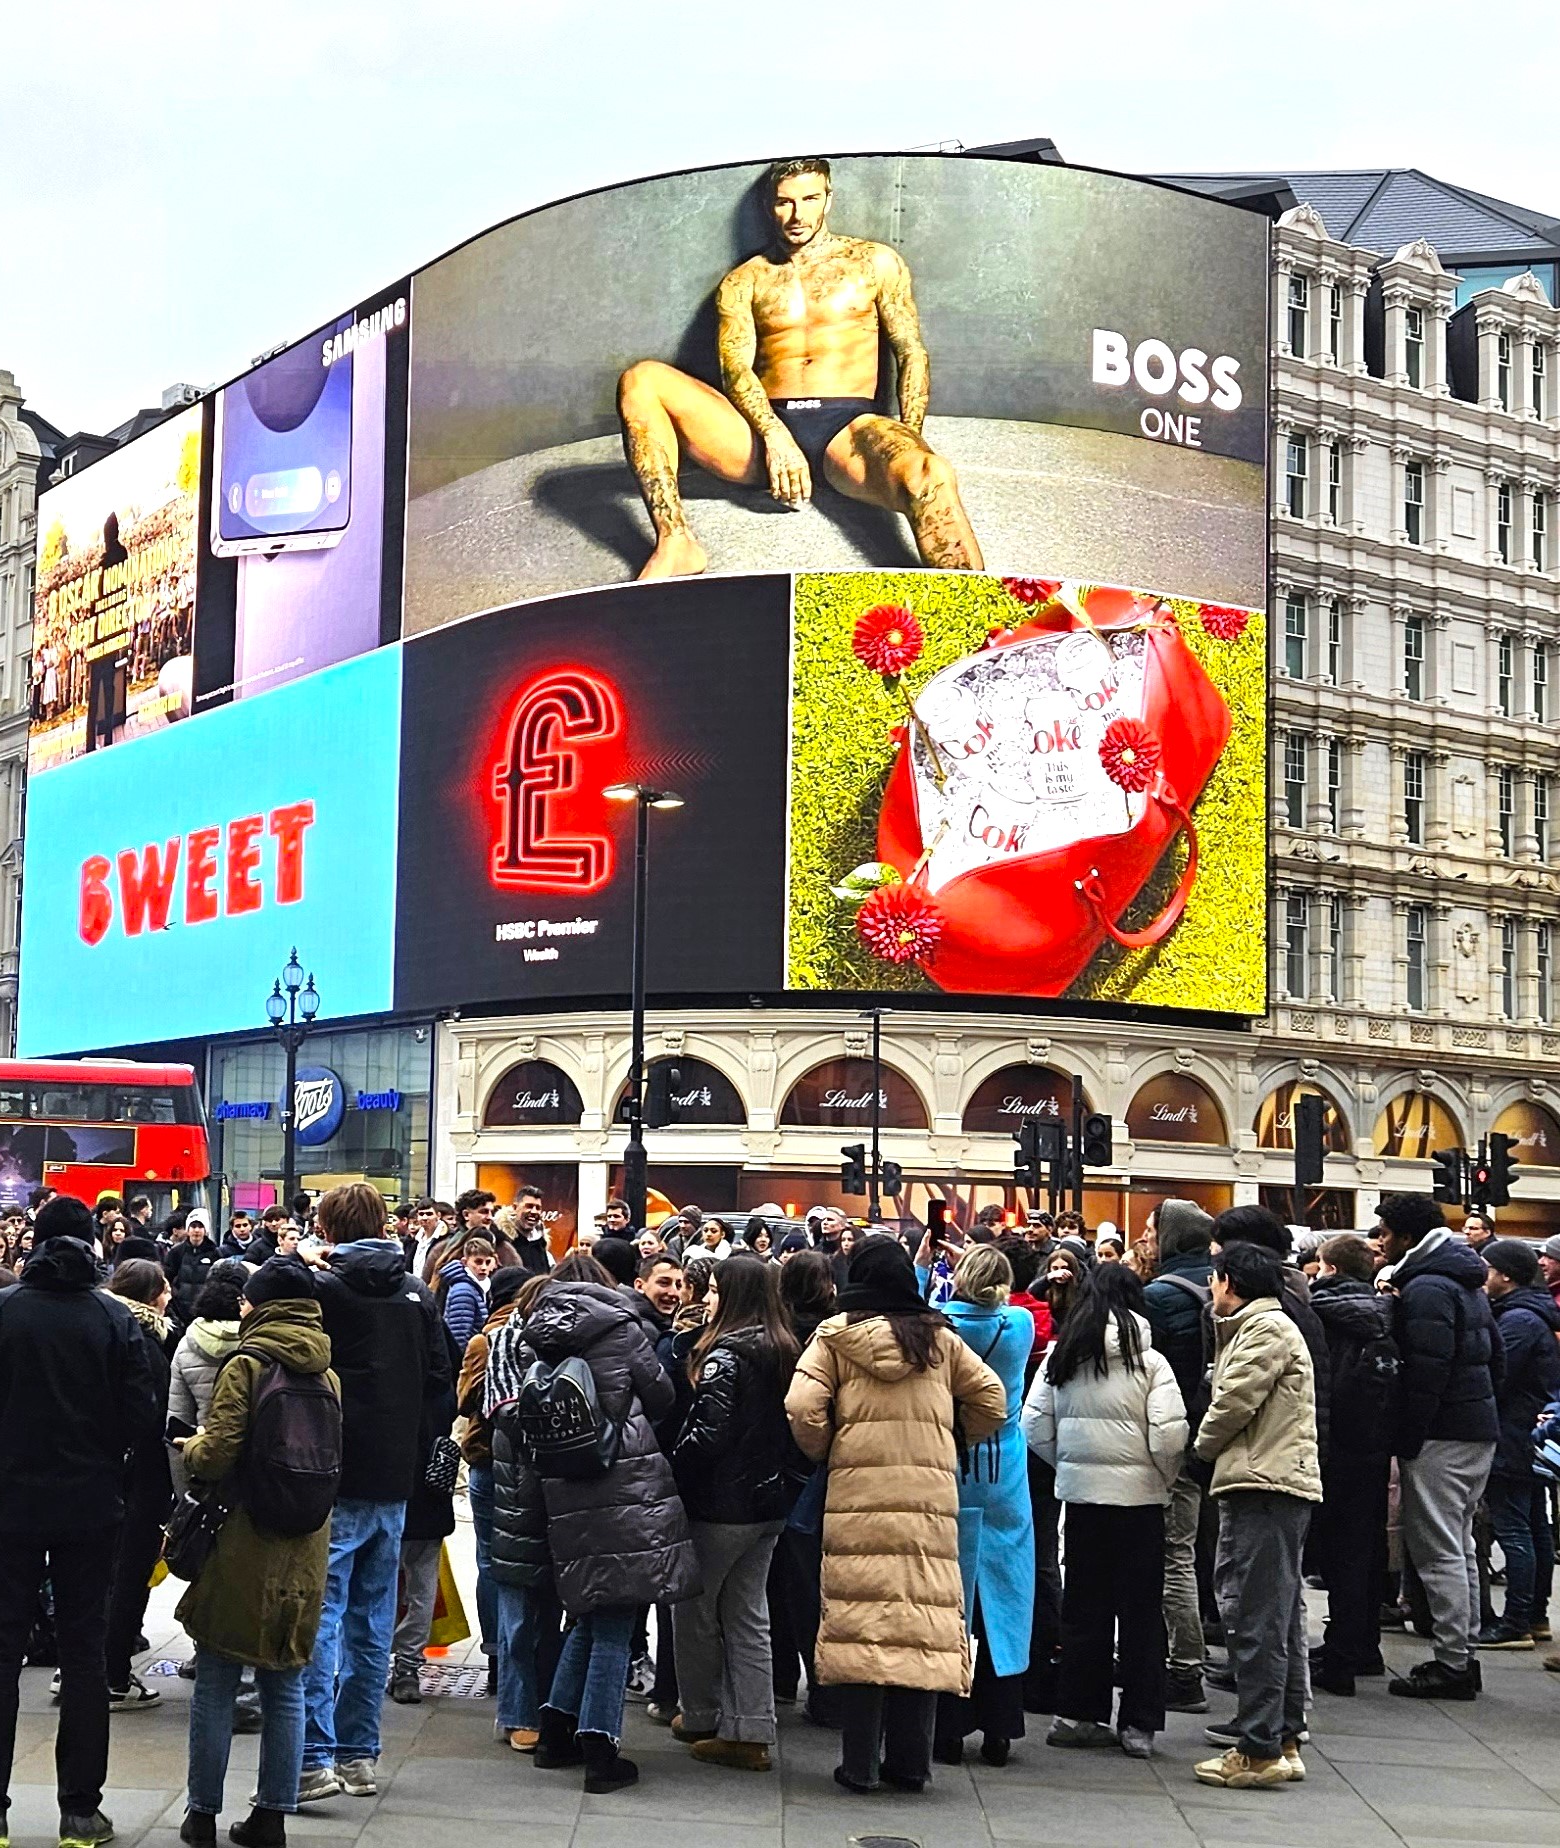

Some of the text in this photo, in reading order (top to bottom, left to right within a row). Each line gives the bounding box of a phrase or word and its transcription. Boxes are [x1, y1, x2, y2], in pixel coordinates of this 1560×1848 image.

[322, 297, 406, 367] SAMSUNG
[1092, 328, 1243, 411] BOSS
[1140, 407, 1202, 447] ONE
[1046, 762, 1070, 774] This
[495, 916, 599, 941] HSBC Premier
[523, 947, 559, 962] Wealth
[215, 1101, 271, 1121] pharmacy
[357, 1089, 401, 1112] beauty
[512, 1091, 551, 1109] Lindt
[819, 1089, 874, 1108] Lindt
[997, 1096, 1047, 1115] Lindt
[1149, 1103, 1187, 1122] Lindt
